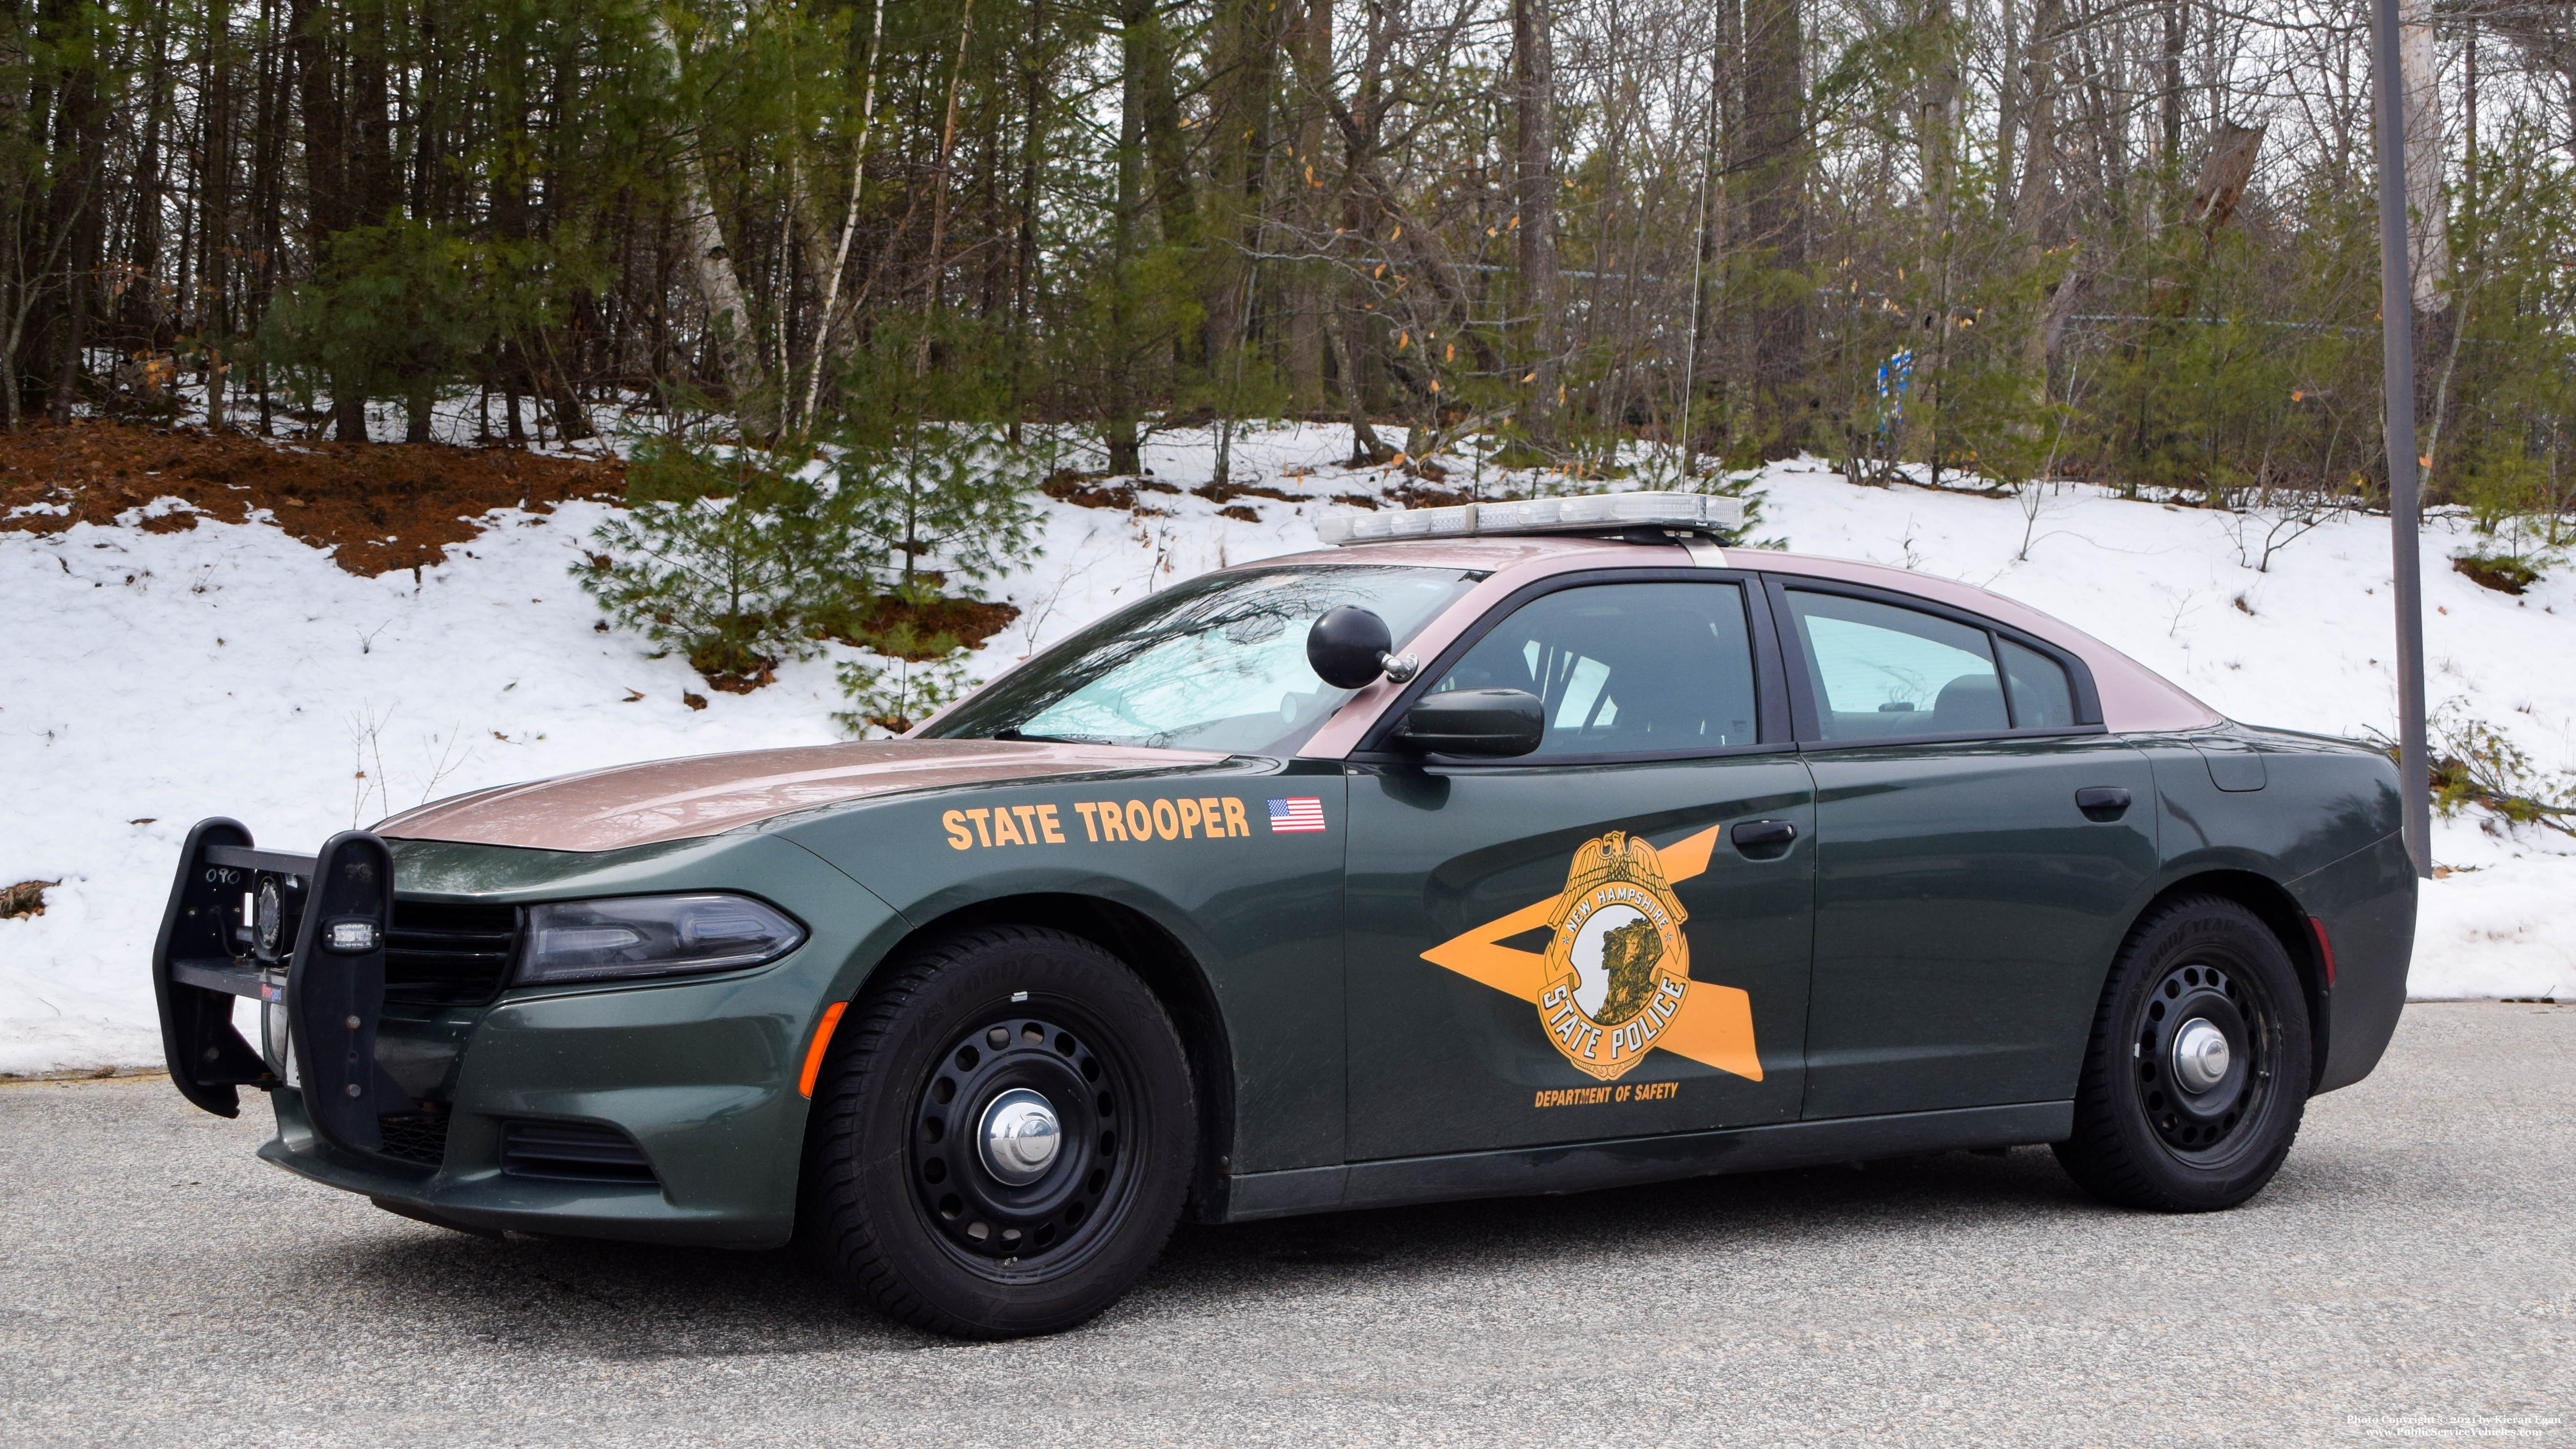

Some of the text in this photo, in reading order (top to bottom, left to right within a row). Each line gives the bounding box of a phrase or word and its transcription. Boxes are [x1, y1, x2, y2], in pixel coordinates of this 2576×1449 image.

[942, 797, 1250, 850] STATE TROOPER
[206, 867, 240, 884] 090
[1566, 887, 1669, 933] NEW HAMPSHIRE
[1543, 977, 1686, 1060] STATE POLICE
[1535, 1082, 1679, 1108] DEPARTMENT OF SAFETY
